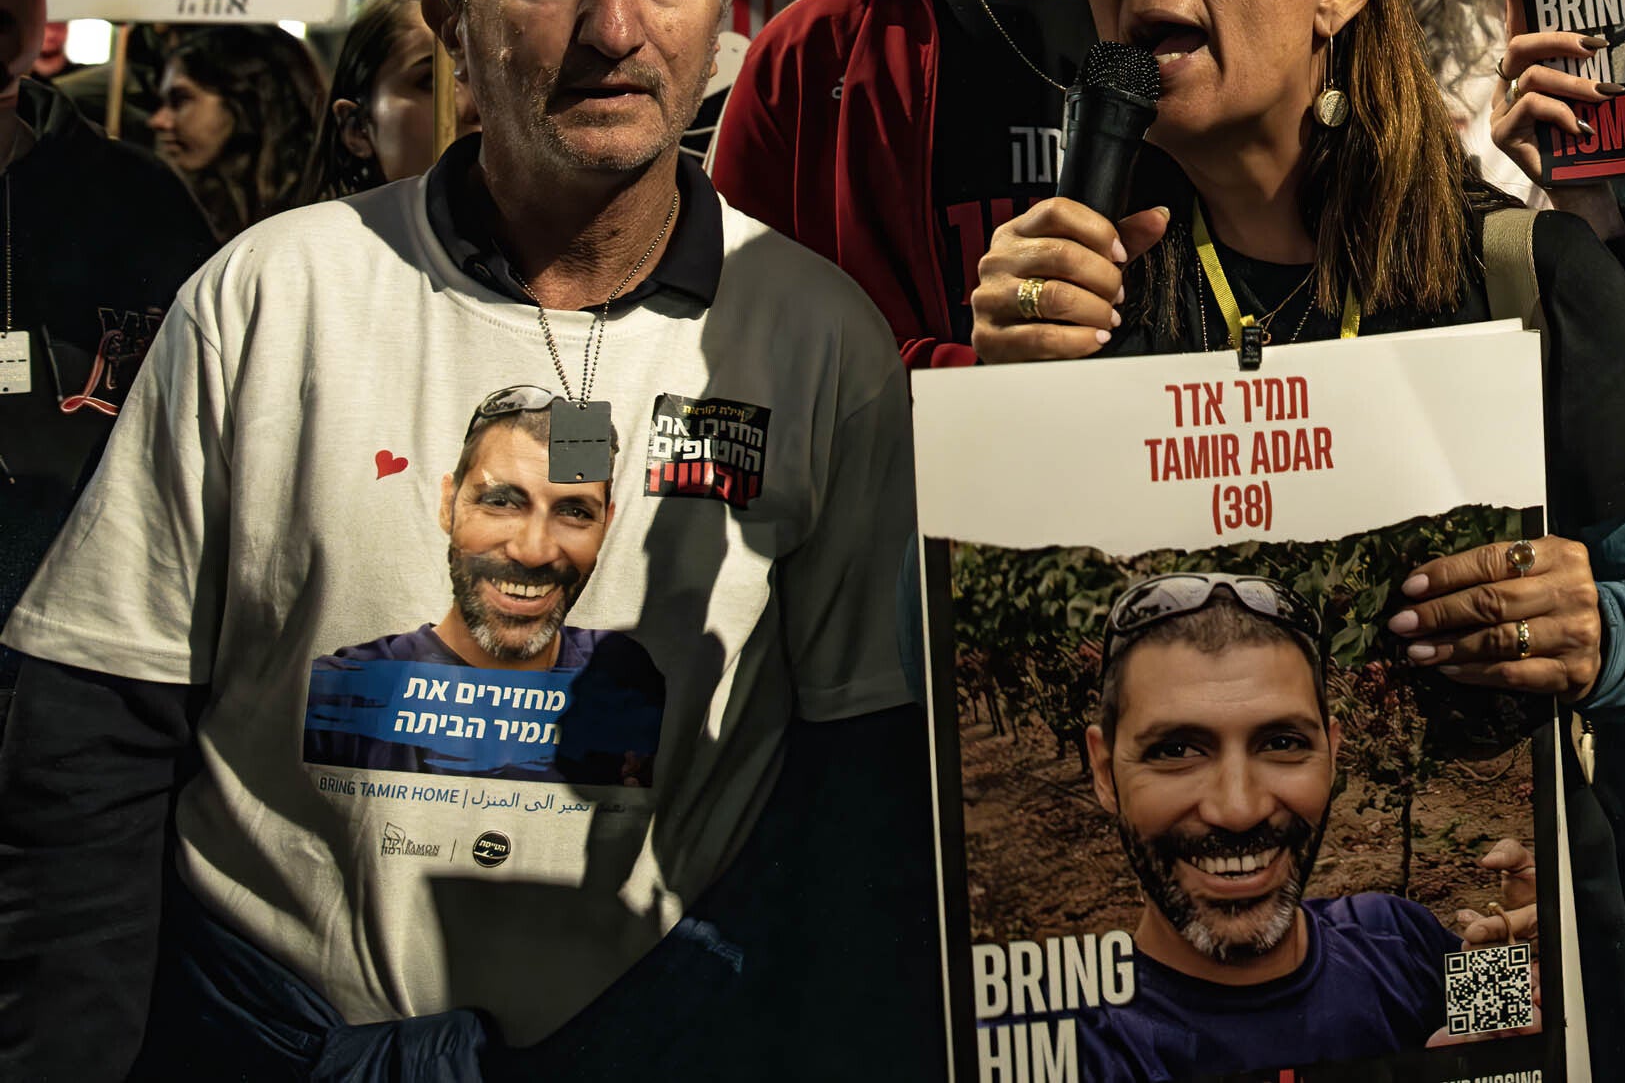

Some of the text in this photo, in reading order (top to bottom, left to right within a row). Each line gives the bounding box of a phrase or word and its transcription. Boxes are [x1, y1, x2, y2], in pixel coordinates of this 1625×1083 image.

[1165, 376, 1310, 427] תמיר אדר
[1145, 427, 1334, 482] TAMIR ADAR
[1212, 479, 1273, 535] (38)
[404, 676, 566, 711] מחזירים את
[394, 710, 561, 746] תמיר הביתה
[319, 779, 460, 804] BRING TAMIR HOME
[972, 930, 1135, 1019] BRING
[978, 1019, 1079, 1083] HIM
